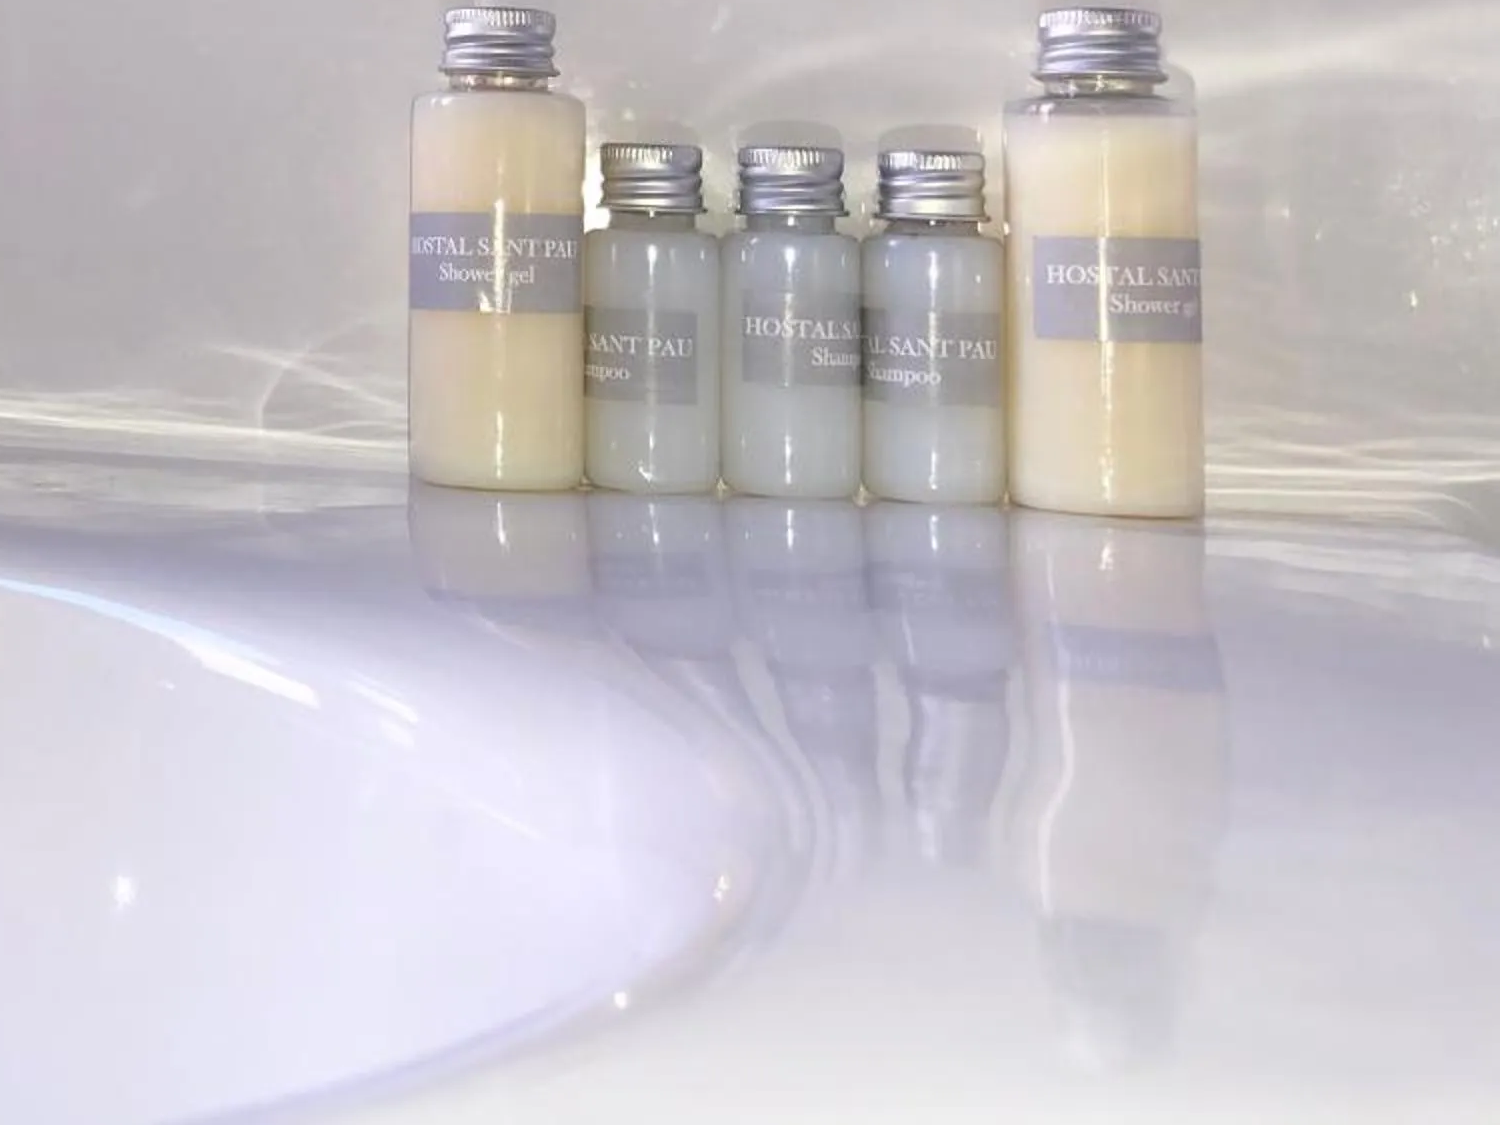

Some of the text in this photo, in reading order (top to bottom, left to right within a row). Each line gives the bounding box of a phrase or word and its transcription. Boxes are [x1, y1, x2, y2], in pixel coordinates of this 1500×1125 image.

[477, 236, 538, 258] SNT
[544, 239, 577, 259] PAU
[438, 261, 535, 286] Showe gel
[1045, 263, 1153, 286] HOSTAL
[1108, 293, 1181, 315] Shower
[744, 316, 840, 340] HOSTAL
[647, 336, 693, 356] PAU
[889, 336, 955, 358] SANT
[959, 339, 997, 360] PAU
